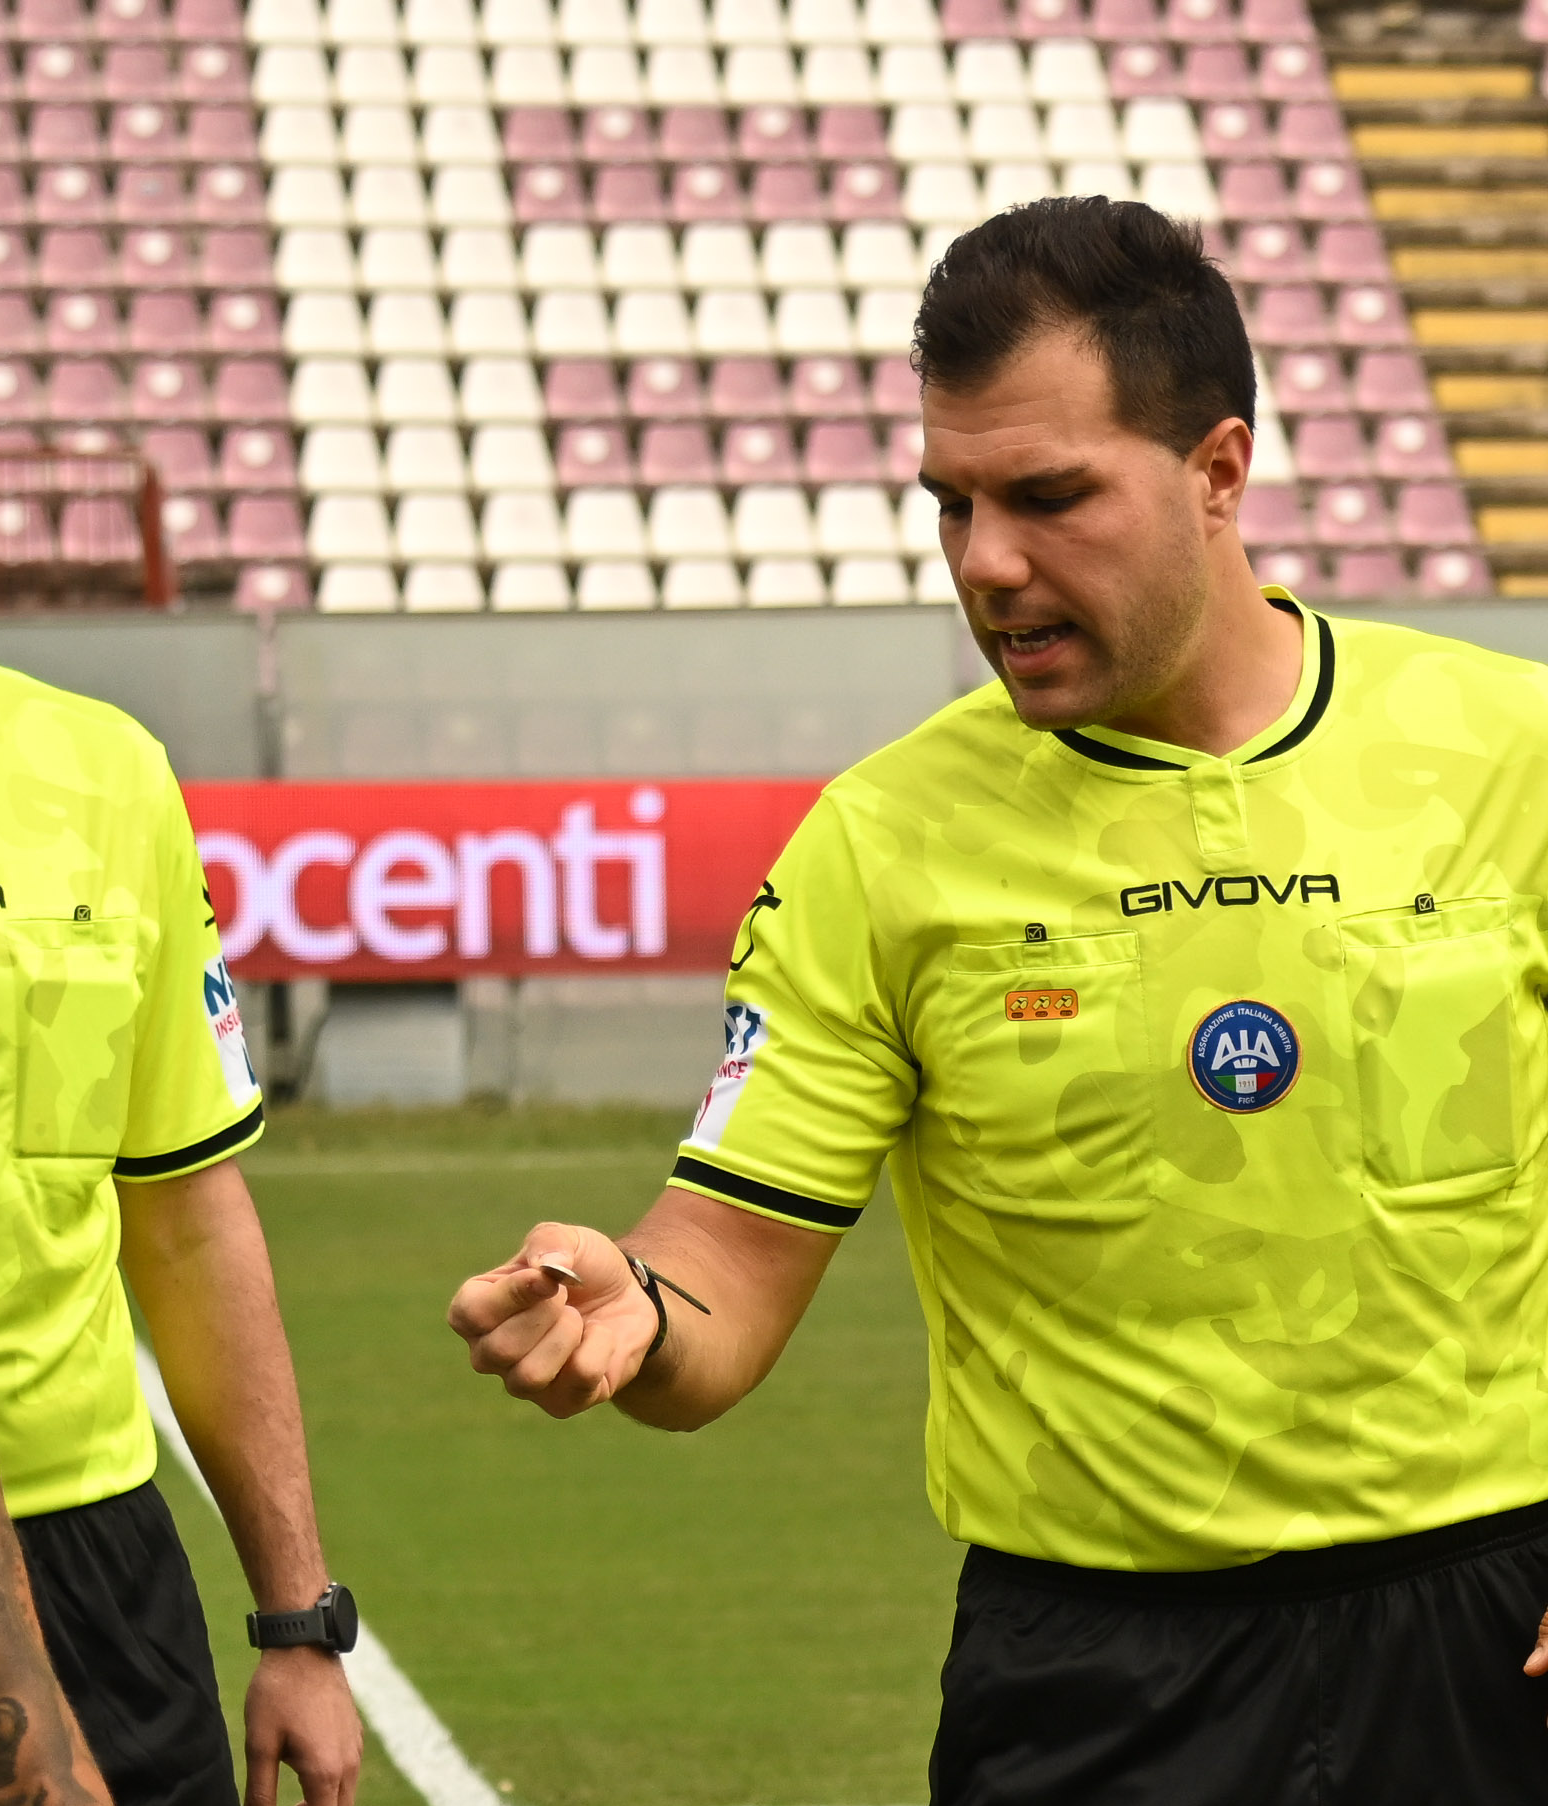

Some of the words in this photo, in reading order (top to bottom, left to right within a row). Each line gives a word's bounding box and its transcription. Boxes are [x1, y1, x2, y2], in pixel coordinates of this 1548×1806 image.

[196, 786, 668, 962] ocenti
[1119, 873, 1341, 918] GIVOVA
[1197, 1009, 1235, 1058] ASSOCIAZIONE
[1237, 1007, 1274, 1025] ITALIANA
[1272, 1022, 1293, 1054] ARBITRI
[1210, 1029, 1281, 1071] AIA
